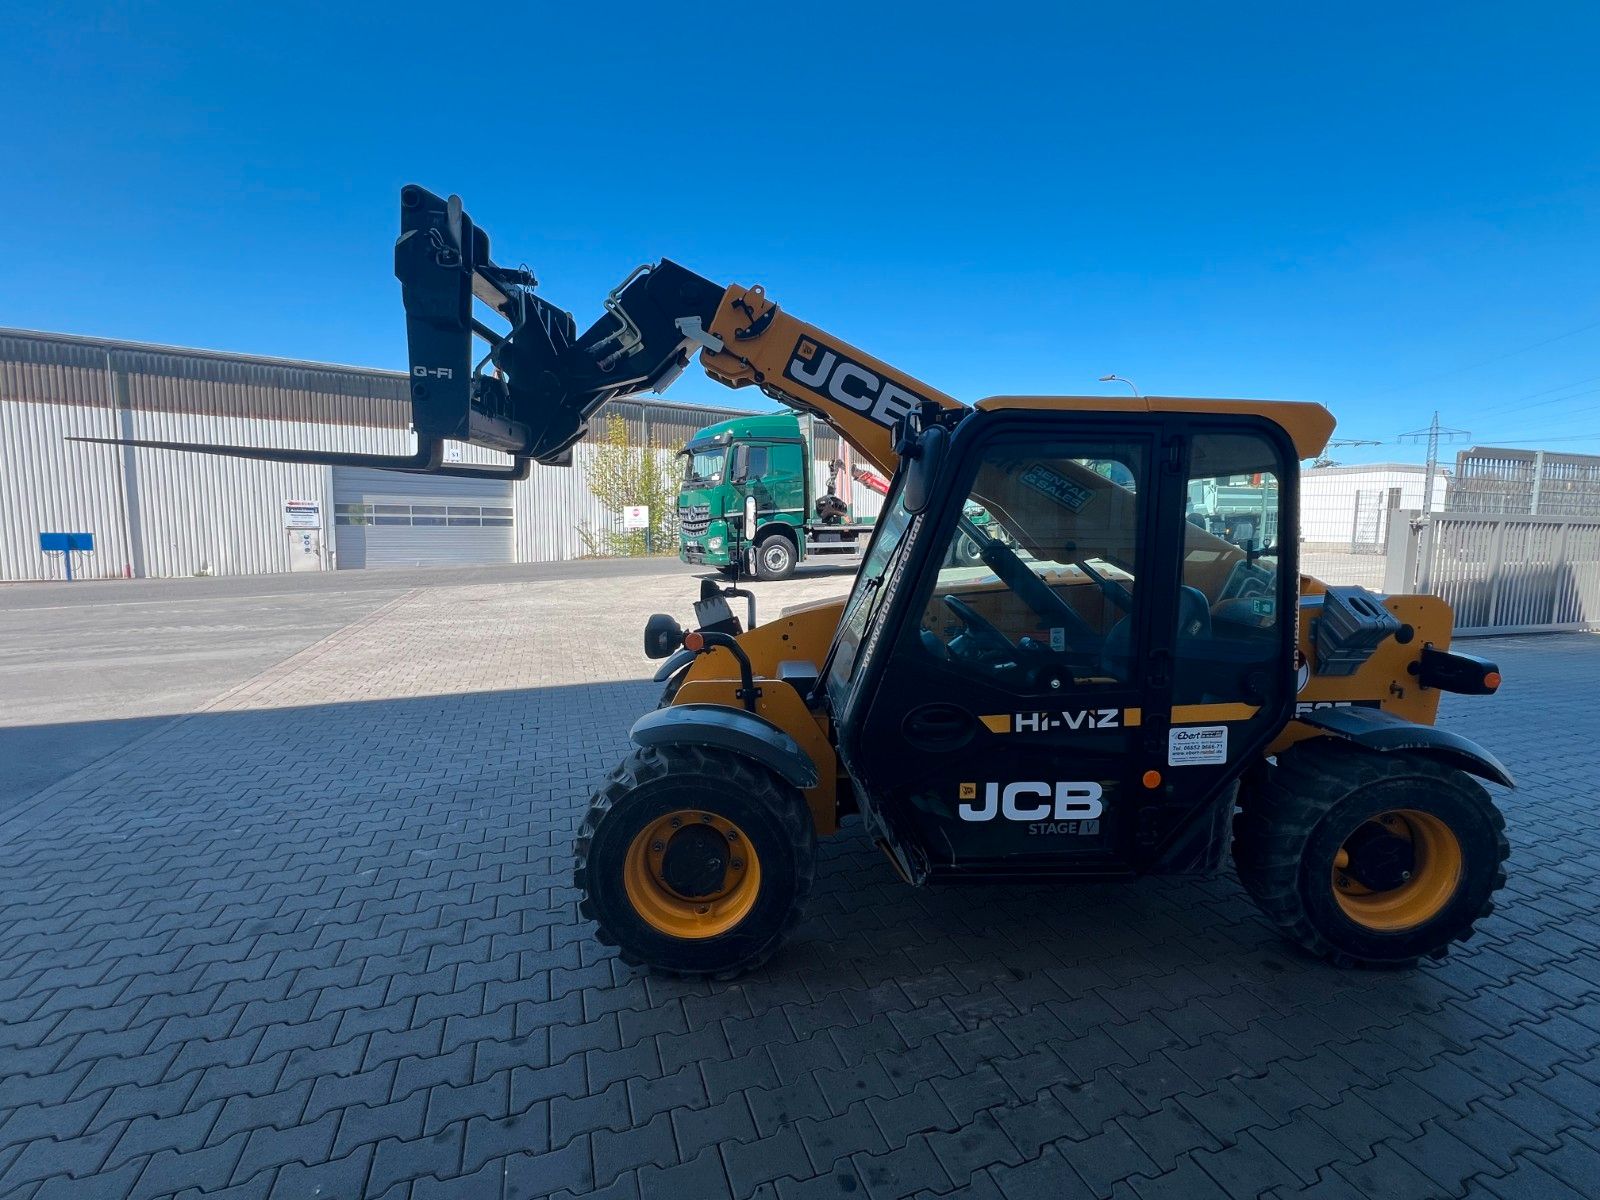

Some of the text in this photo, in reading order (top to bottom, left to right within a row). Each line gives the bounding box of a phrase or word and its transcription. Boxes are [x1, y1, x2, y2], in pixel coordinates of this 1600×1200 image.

[413, 365, 453, 379] Q-FI
[790, 351, 922, 427] JCB
[1023, 473, 1082, 508] & SALES
[1031, 465, 1087, 500] RENTAL
[862, 513, 925, 668] www.ebert-rental.
[1177, 731, 1200, 740] Ebert
[958, 781, 1103, 822] JCB
[1028, 821, 1097, 835] STAGE V
